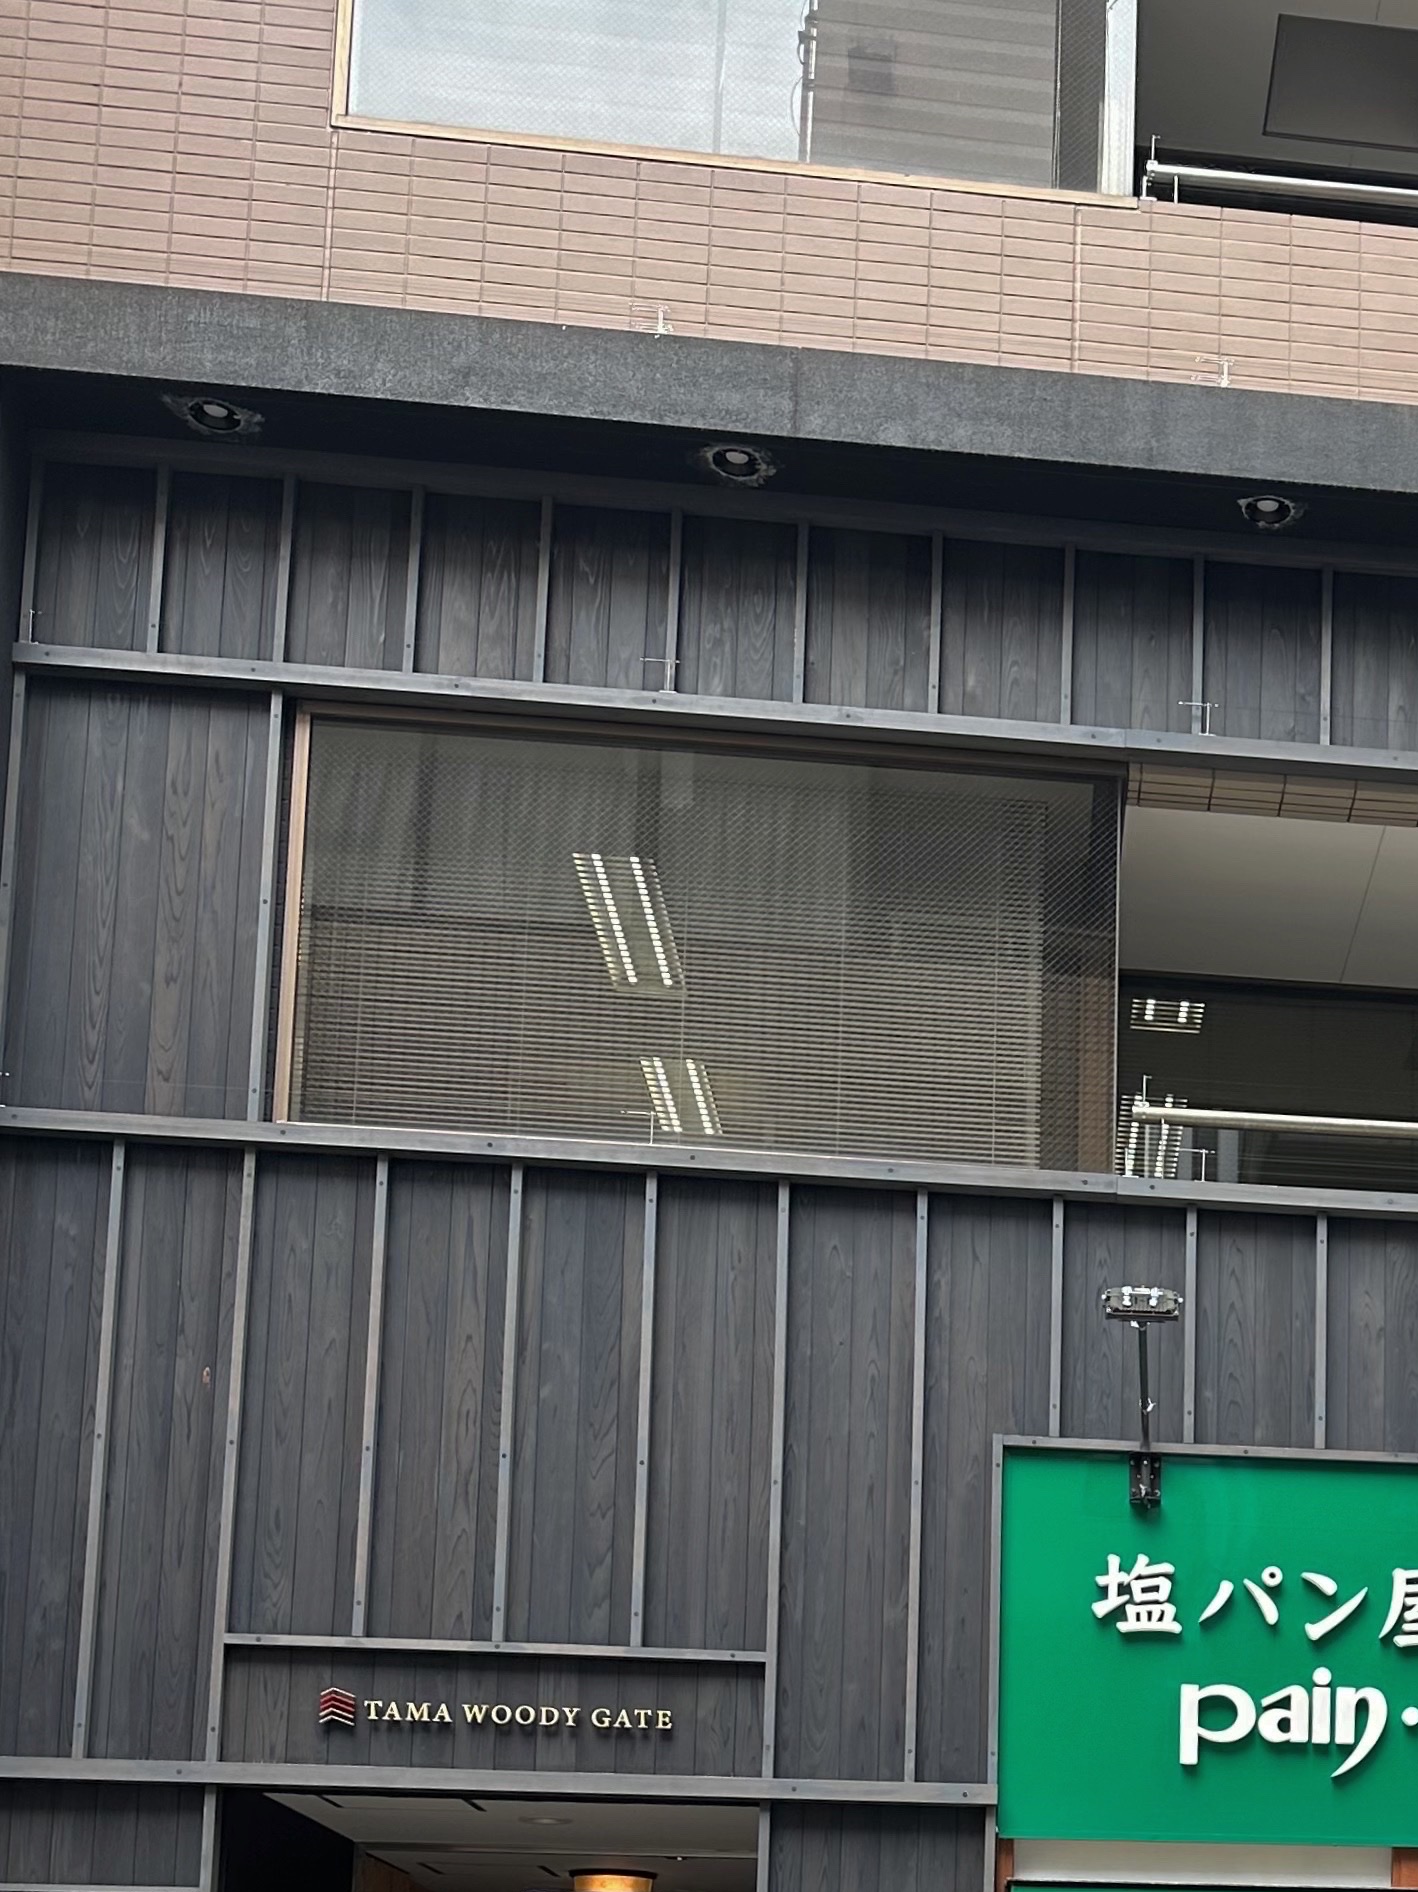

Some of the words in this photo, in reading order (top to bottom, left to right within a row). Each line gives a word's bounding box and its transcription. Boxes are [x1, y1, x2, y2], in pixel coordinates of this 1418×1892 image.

[364, 1700, 453, 1723] TAMA
[462, 1703, 581, 1727] WOODY
[590, 1707, 674, 1730] GATE
